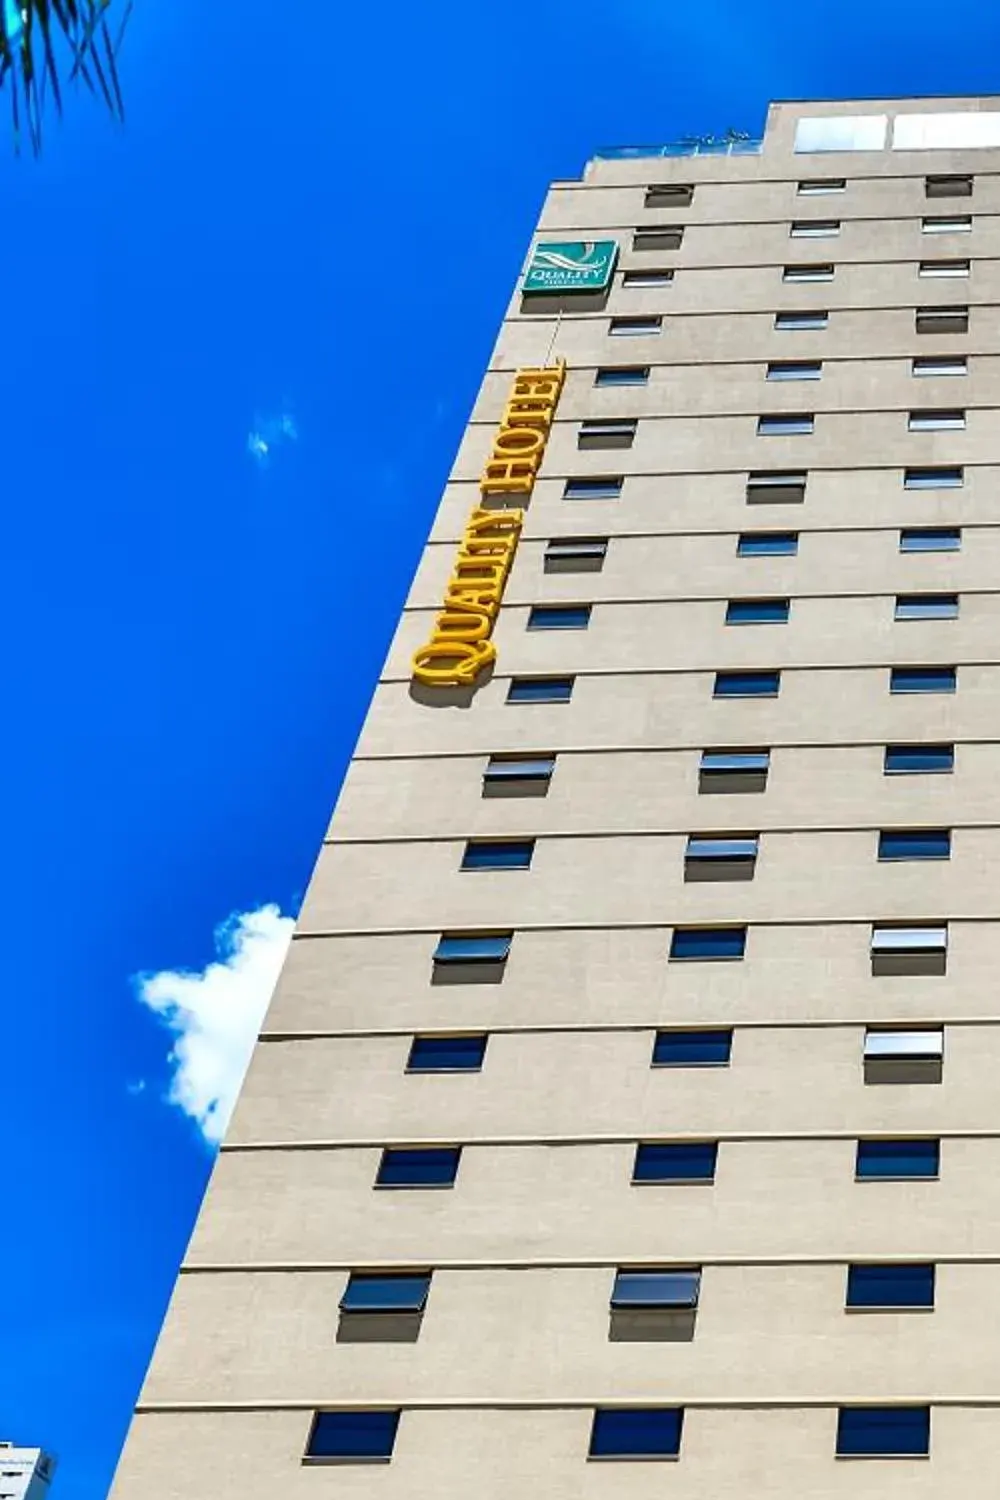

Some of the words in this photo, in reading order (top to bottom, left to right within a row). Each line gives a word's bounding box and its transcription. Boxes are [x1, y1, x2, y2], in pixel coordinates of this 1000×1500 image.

[530, 269, 603, 281] QUALITY
[411, 506, 524, 686] QUALITY
[480, 356, 567, 493] HOTEL
